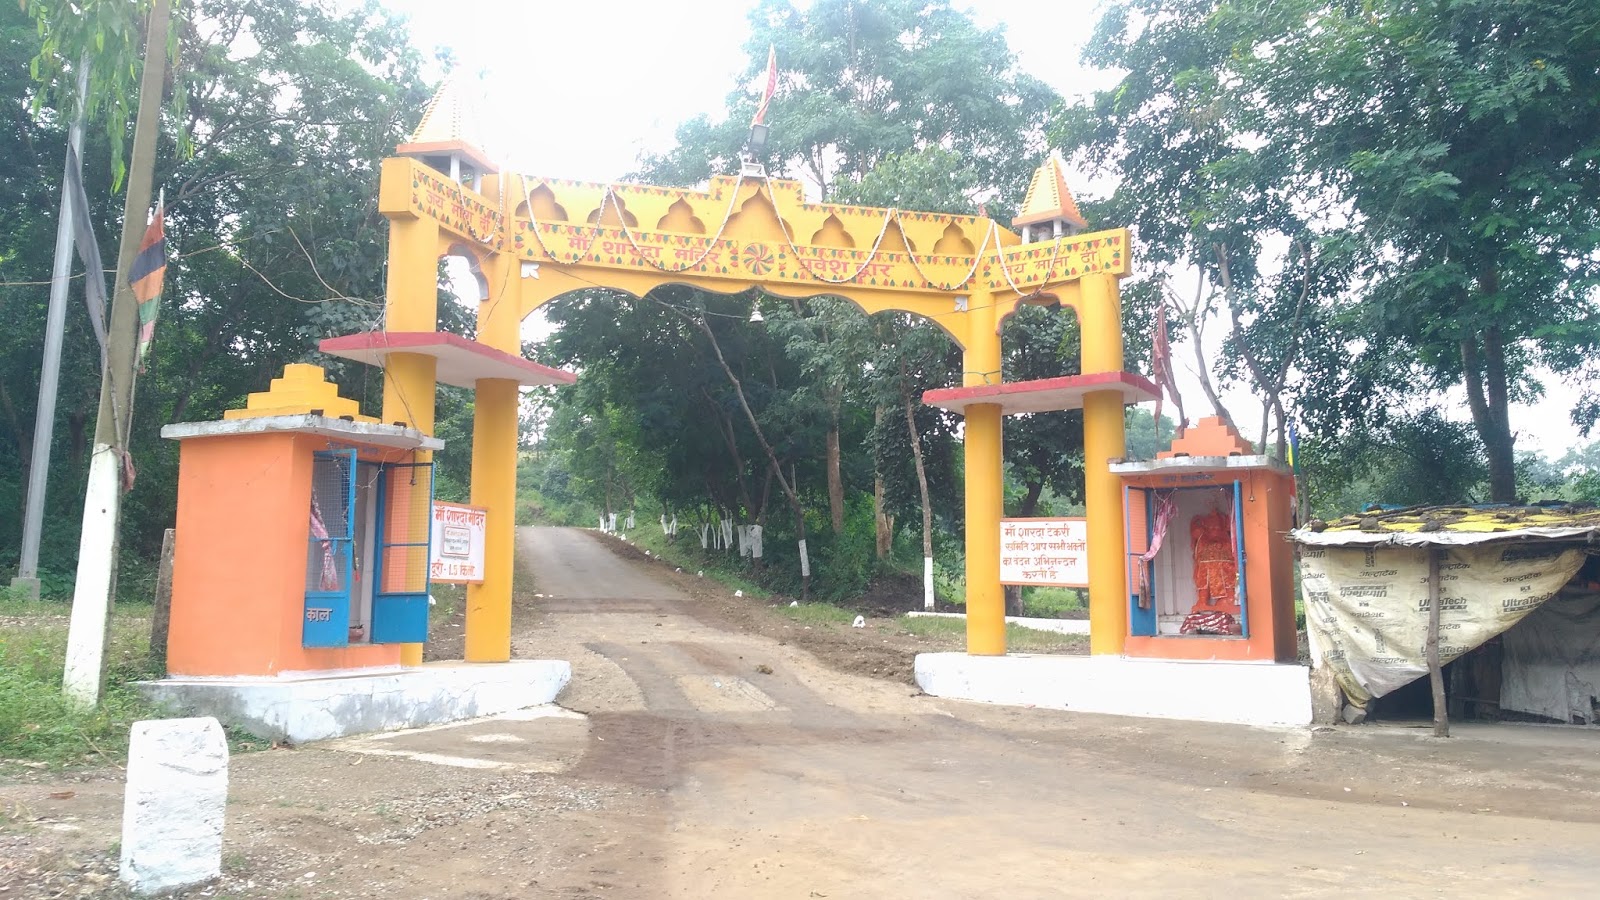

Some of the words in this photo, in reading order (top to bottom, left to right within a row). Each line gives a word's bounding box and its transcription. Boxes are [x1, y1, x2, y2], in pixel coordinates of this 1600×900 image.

[602, 241, 664, 258] शारदा
[799, 257, 850, 274] प्रवेश
[1018, 527, 1045, 538] शारदा
[1031, 542, 1047, 551] आप
[1502, 592, 1553, 608] UltraTech
[306, 607, 333, 622] काल
